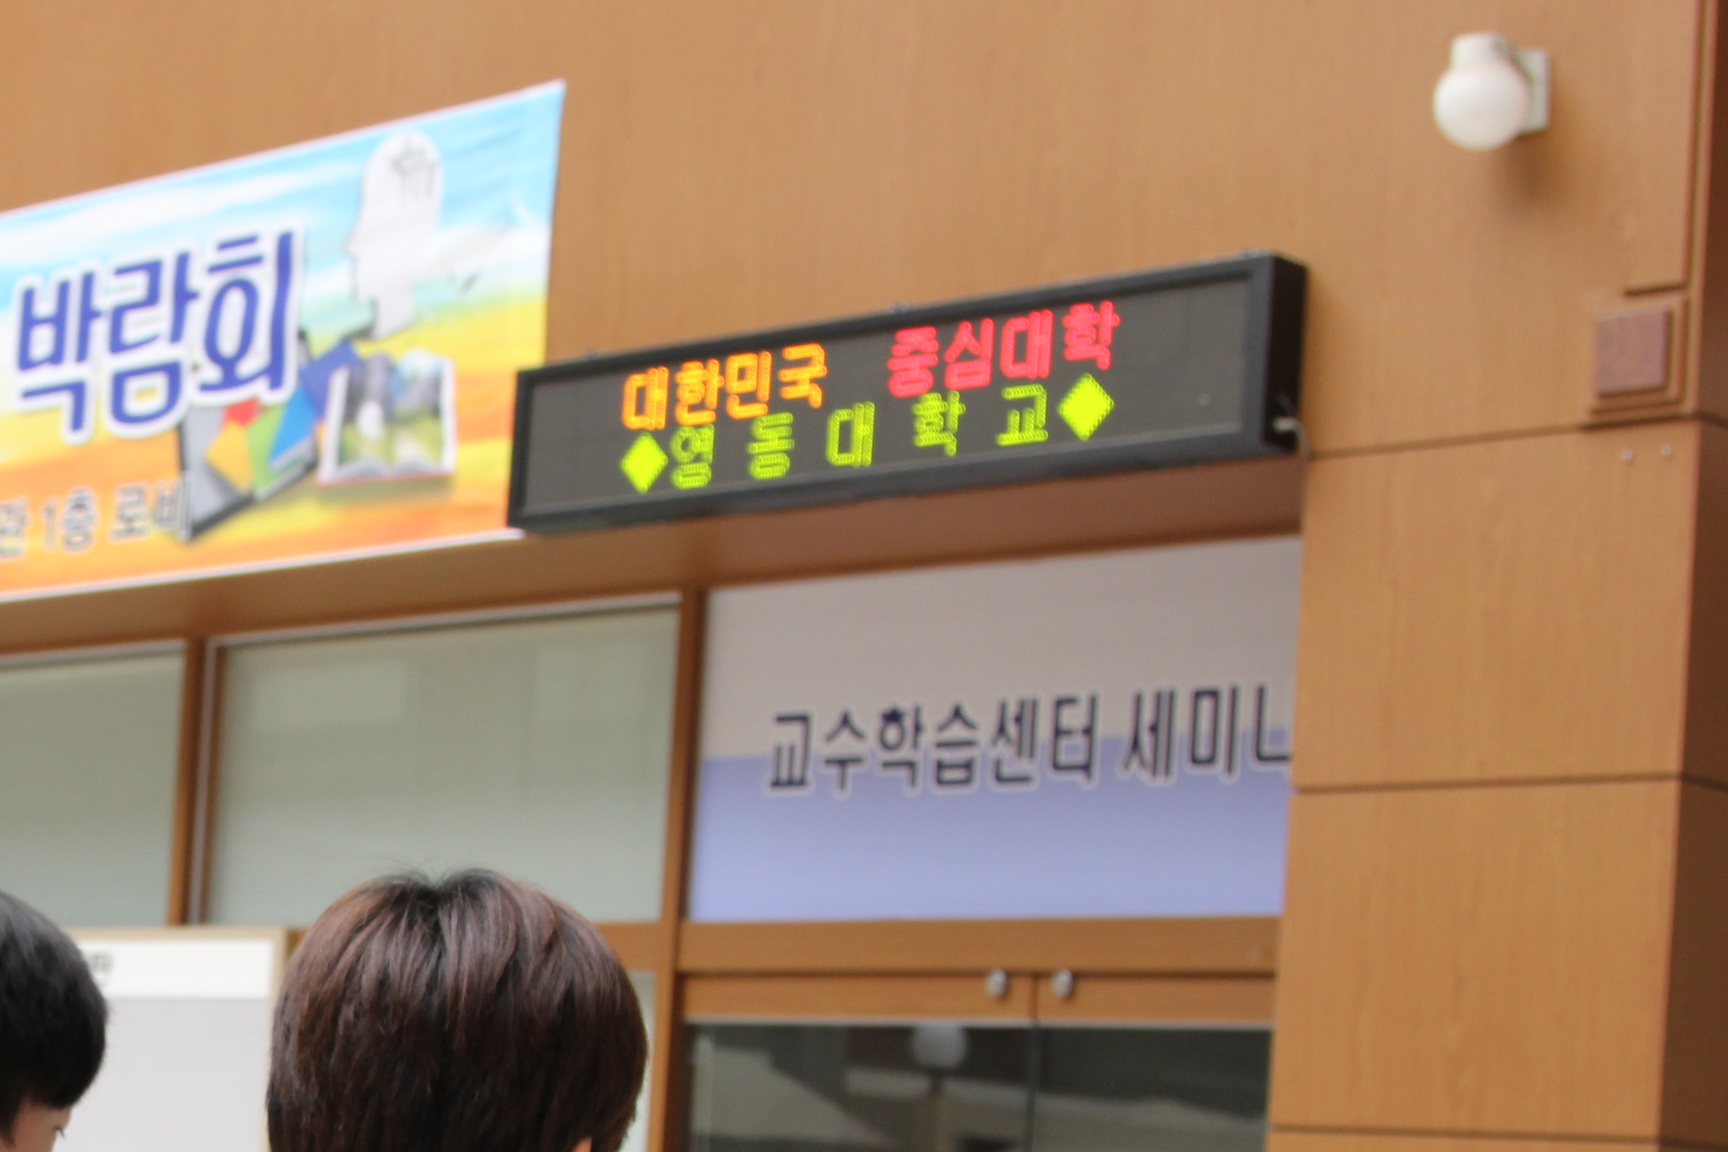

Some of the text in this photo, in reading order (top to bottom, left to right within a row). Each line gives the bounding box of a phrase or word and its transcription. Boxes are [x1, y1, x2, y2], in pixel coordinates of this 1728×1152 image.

[15, 230, 296, 434] 박람회
[622, 301, 1121, 432] 대한민국 중심대학
[768, 692, 1097, 791] 교수학습센터
